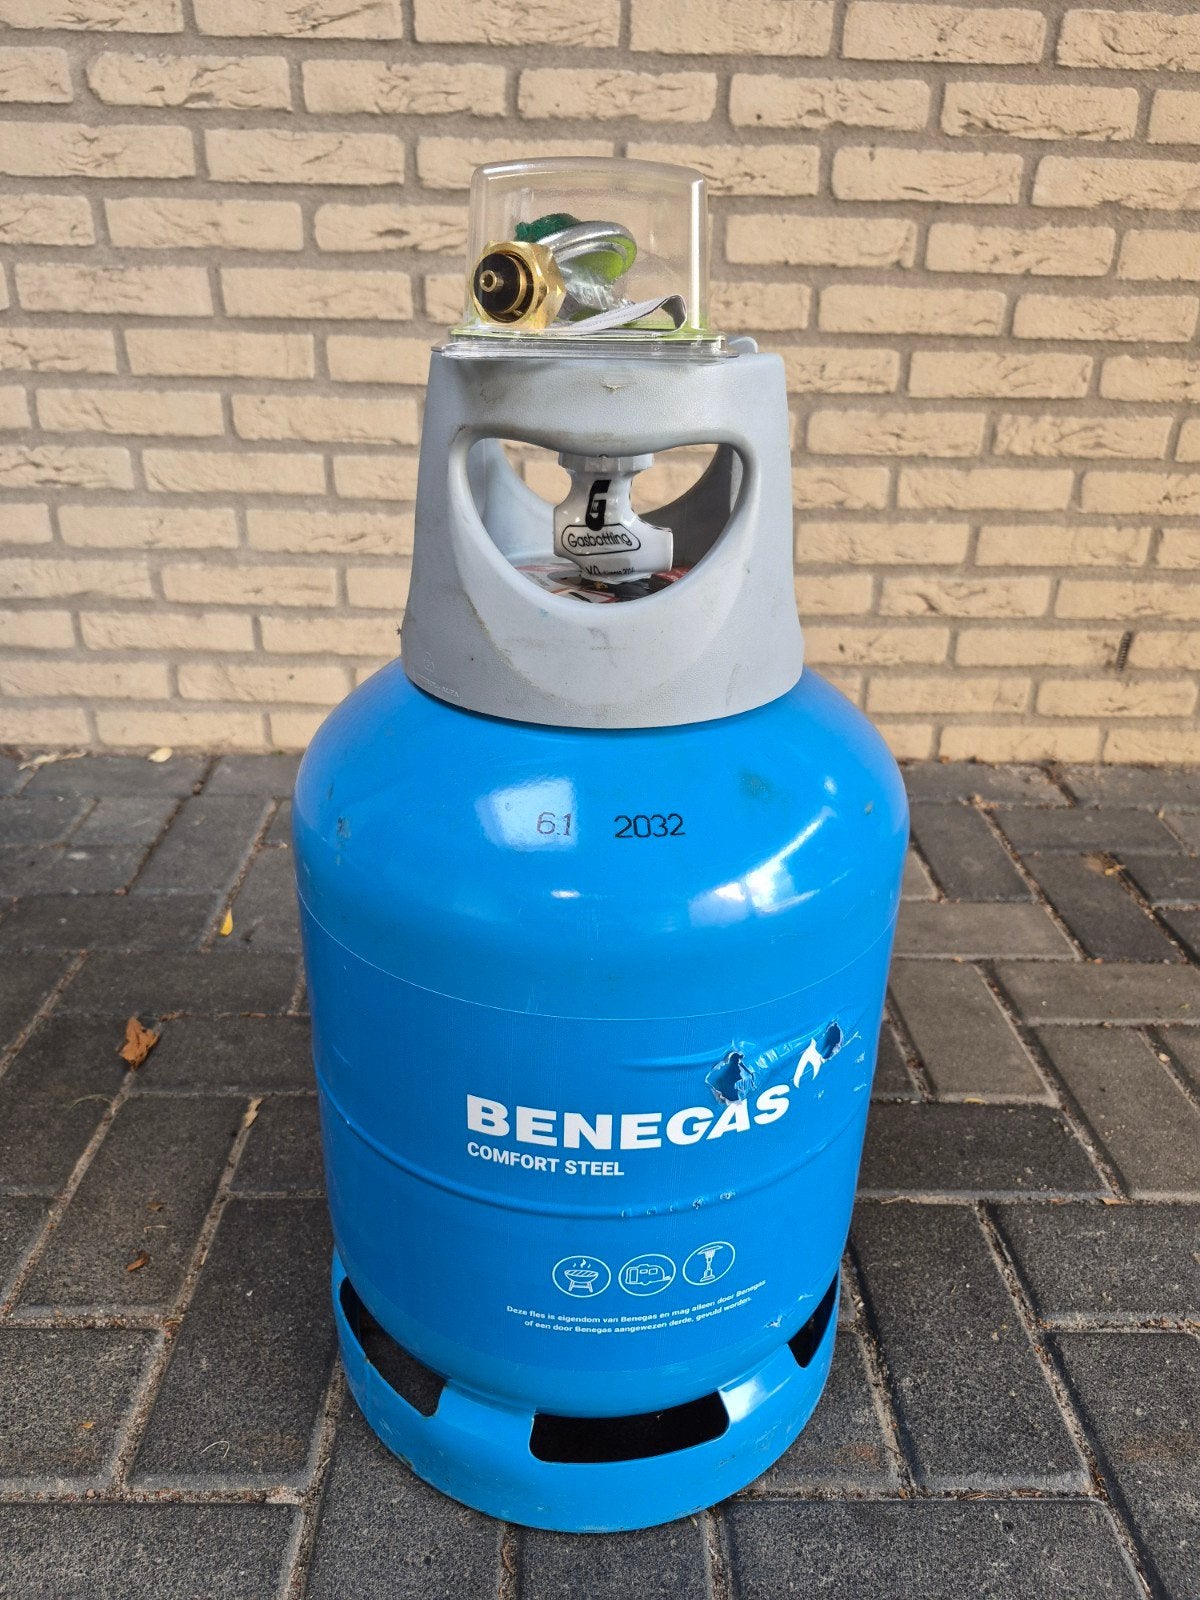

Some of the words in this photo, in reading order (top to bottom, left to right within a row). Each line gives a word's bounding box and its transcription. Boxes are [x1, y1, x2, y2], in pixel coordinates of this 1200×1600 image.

[567, 532, 633, 548] Gasbottling
[537, 812, 571, 836] 6.1
[614, 813, 686, 839] 2032
[466, 1084, 790, 1150] BENEGAS
[467, 1142, 560, 1172] COMFORT
[565, 1160, 625, 1176] STEEL
[506, 1305, 528, 1315] Deze
[529, 1310, 546, 1319] fles
[557, 1315, 601, 1323] eigendom
[620, 1315, 658, 1323] Benegas
[671, 1306, 690, 1315] mag
[691, 1301, 716, 1312] alleen
[717, 1294, 735, 1304] door
[736, 1279, 766, 1297] Benegas
[535, 1322, 551, 1330] een
[552, 1323, 573, 1332] door
[574, 1325, 612, 1334] Benegas
[614, 1322, 668, 1333] aangewezen
[696, 1307, 722, 1321] gevuld
[724, 1297, 752, 1310] worden.
